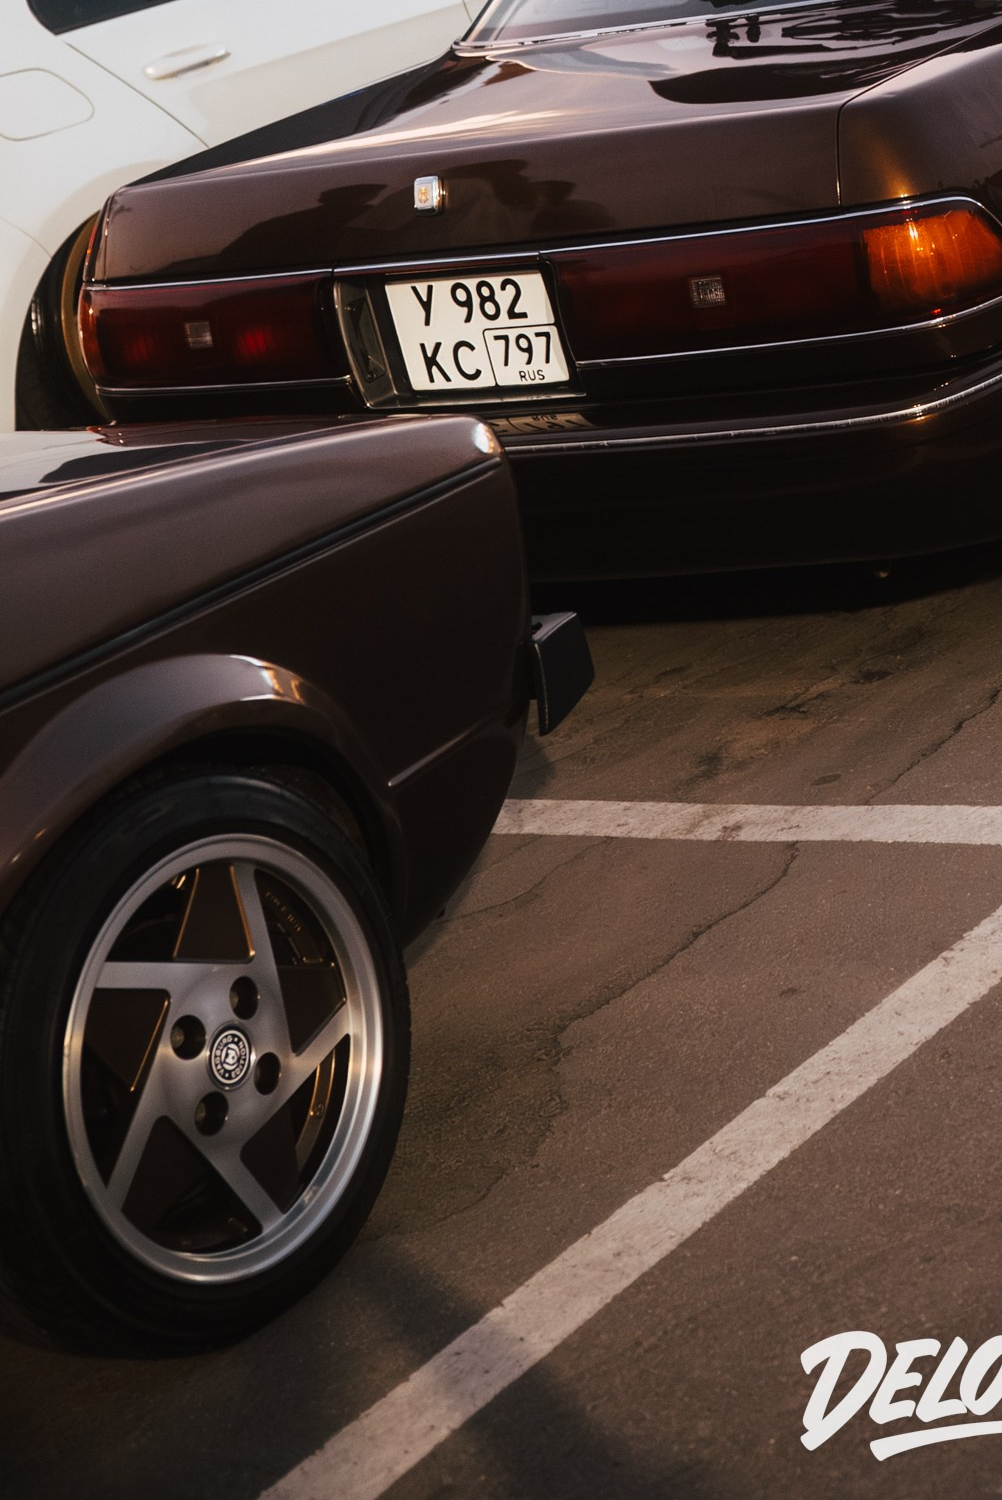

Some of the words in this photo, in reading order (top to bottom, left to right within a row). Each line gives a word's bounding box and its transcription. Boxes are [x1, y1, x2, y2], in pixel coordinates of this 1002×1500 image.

[450, 278, 528, 323] 982
[493, 331, 551, 367] 797
[518, 369, 545, 381] RUS
